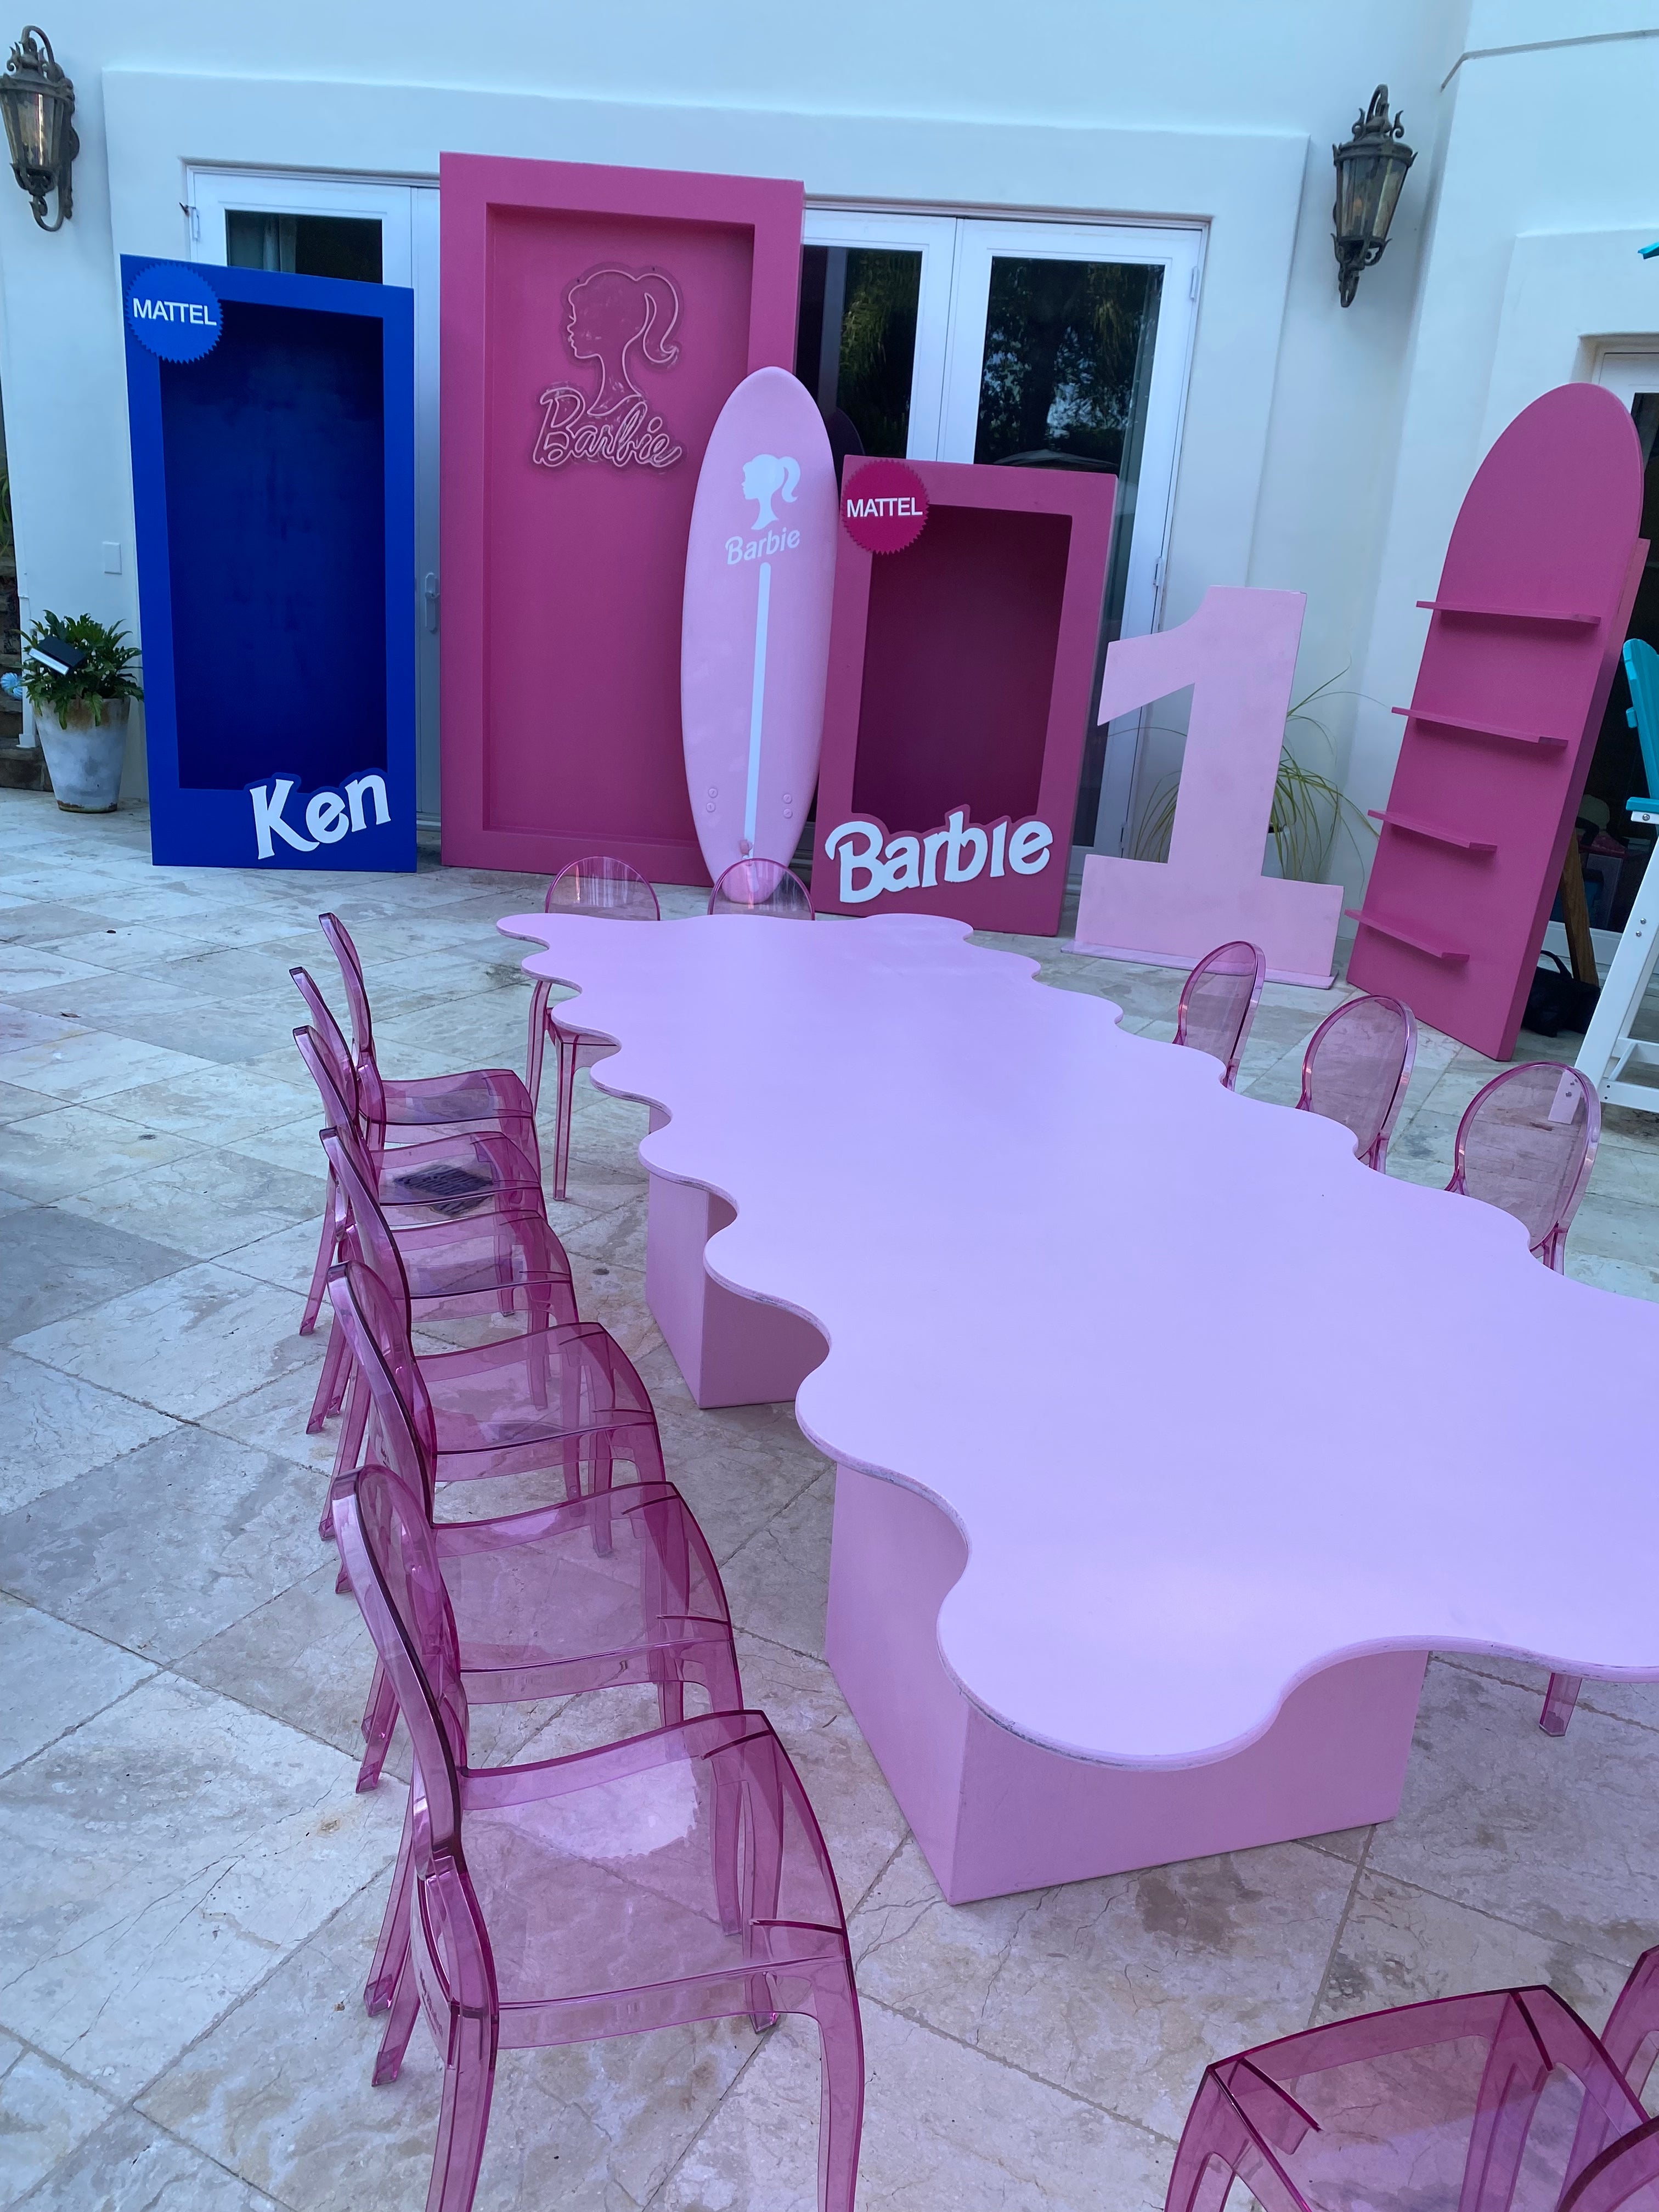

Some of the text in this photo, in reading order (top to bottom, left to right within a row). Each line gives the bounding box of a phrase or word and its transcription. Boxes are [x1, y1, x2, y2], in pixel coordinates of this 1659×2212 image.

[133, 297, 217, 326] MATTEL
[533, 387, 682, 467] Barbie
[725, 527, 800, 565] Barbie
[847, 496, 923, 517] MATTEL
[249, 774, 391, 860] Ken
[1075, 585, 1345, 977] 1
[825, 811, 1054, 904] Barbie
